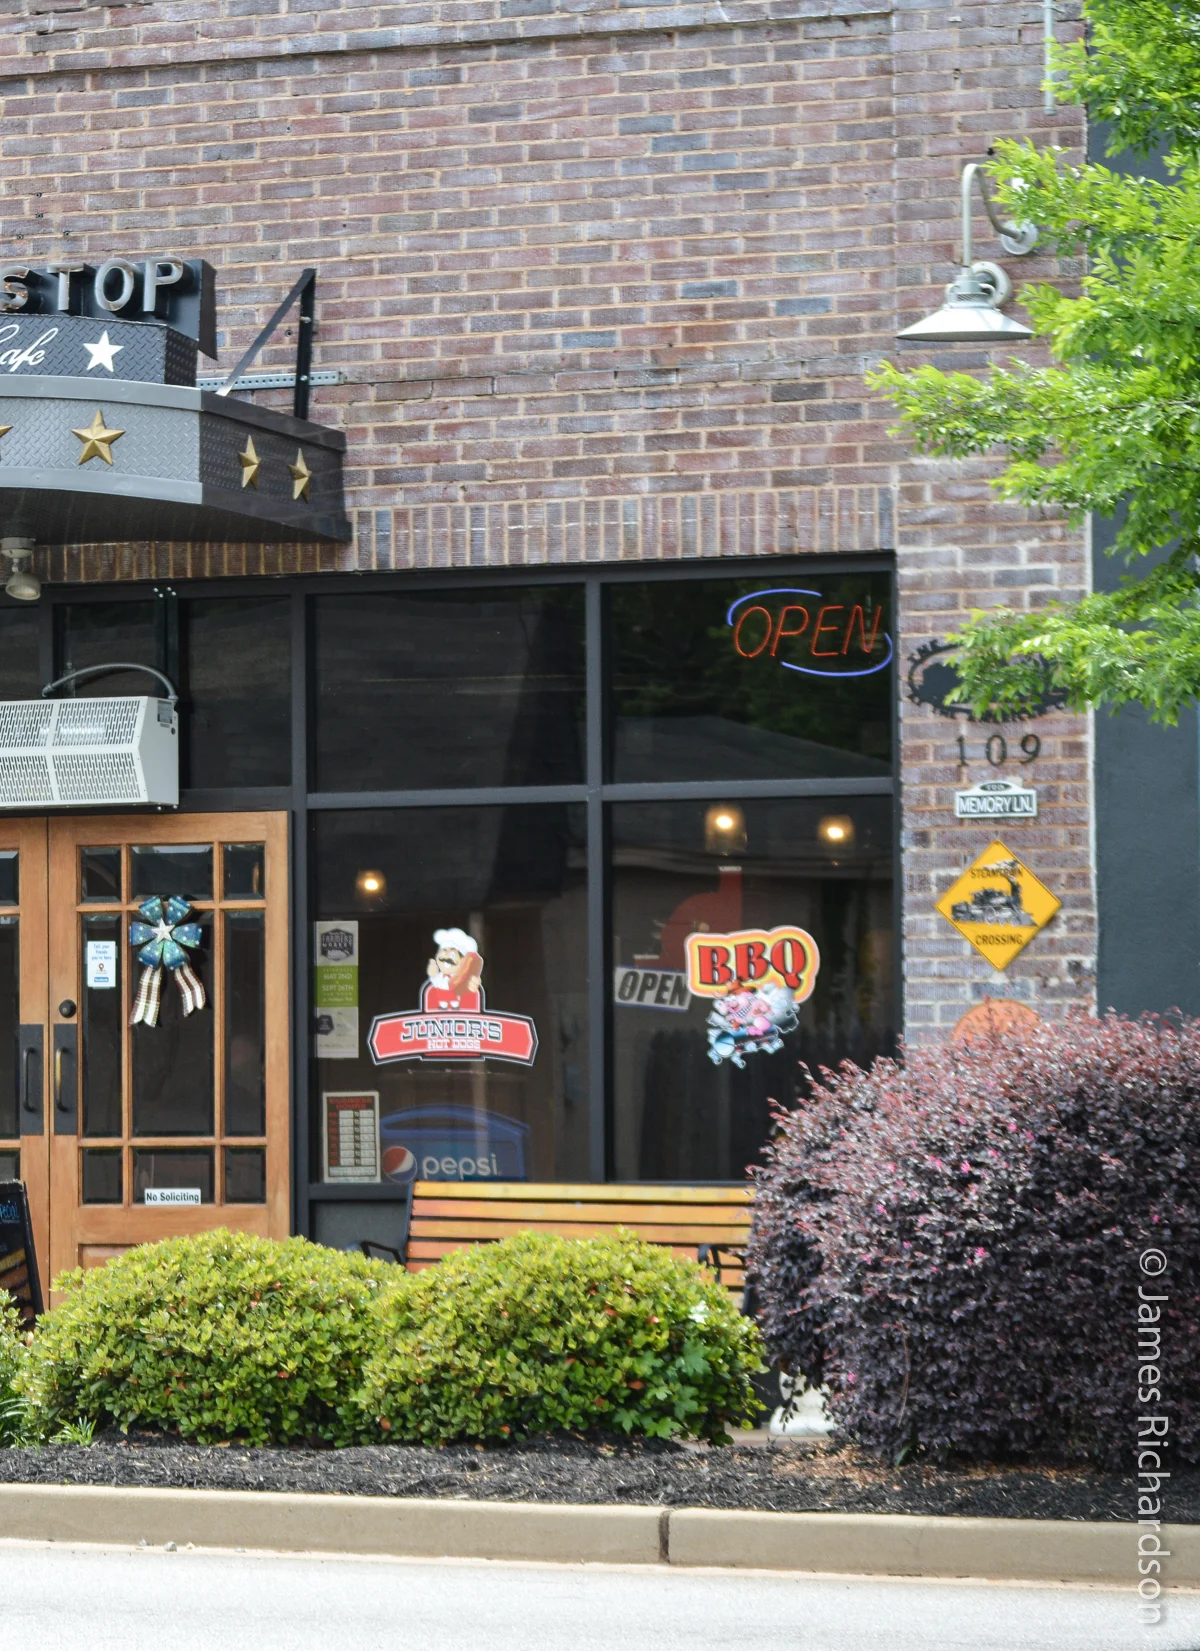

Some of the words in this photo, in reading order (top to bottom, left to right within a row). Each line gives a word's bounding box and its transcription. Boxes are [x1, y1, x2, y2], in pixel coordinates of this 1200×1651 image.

[733, 604, 882, 658] OPEN
[956, 734, 1041, 767] 109
[959, 795, 1011, 814] MEMORY
[1014, 795, 1032, 813] LN.
[975, 934, 1023, 946] CROSSING
[697, 938, 806, 990] BBQ
[618, 970, 688, 1007] OPEN
[401, 1018, 502, 1042] JUNIOR'S
[427, 1040, 450, 1049] HOT
[452, 1040, 480, 1049] DOGS
[422, 1153, 498, 1180] pepsi
[146, 1192, 157, 1203] No
[160, 1191, 200, 1205] Soliciting
